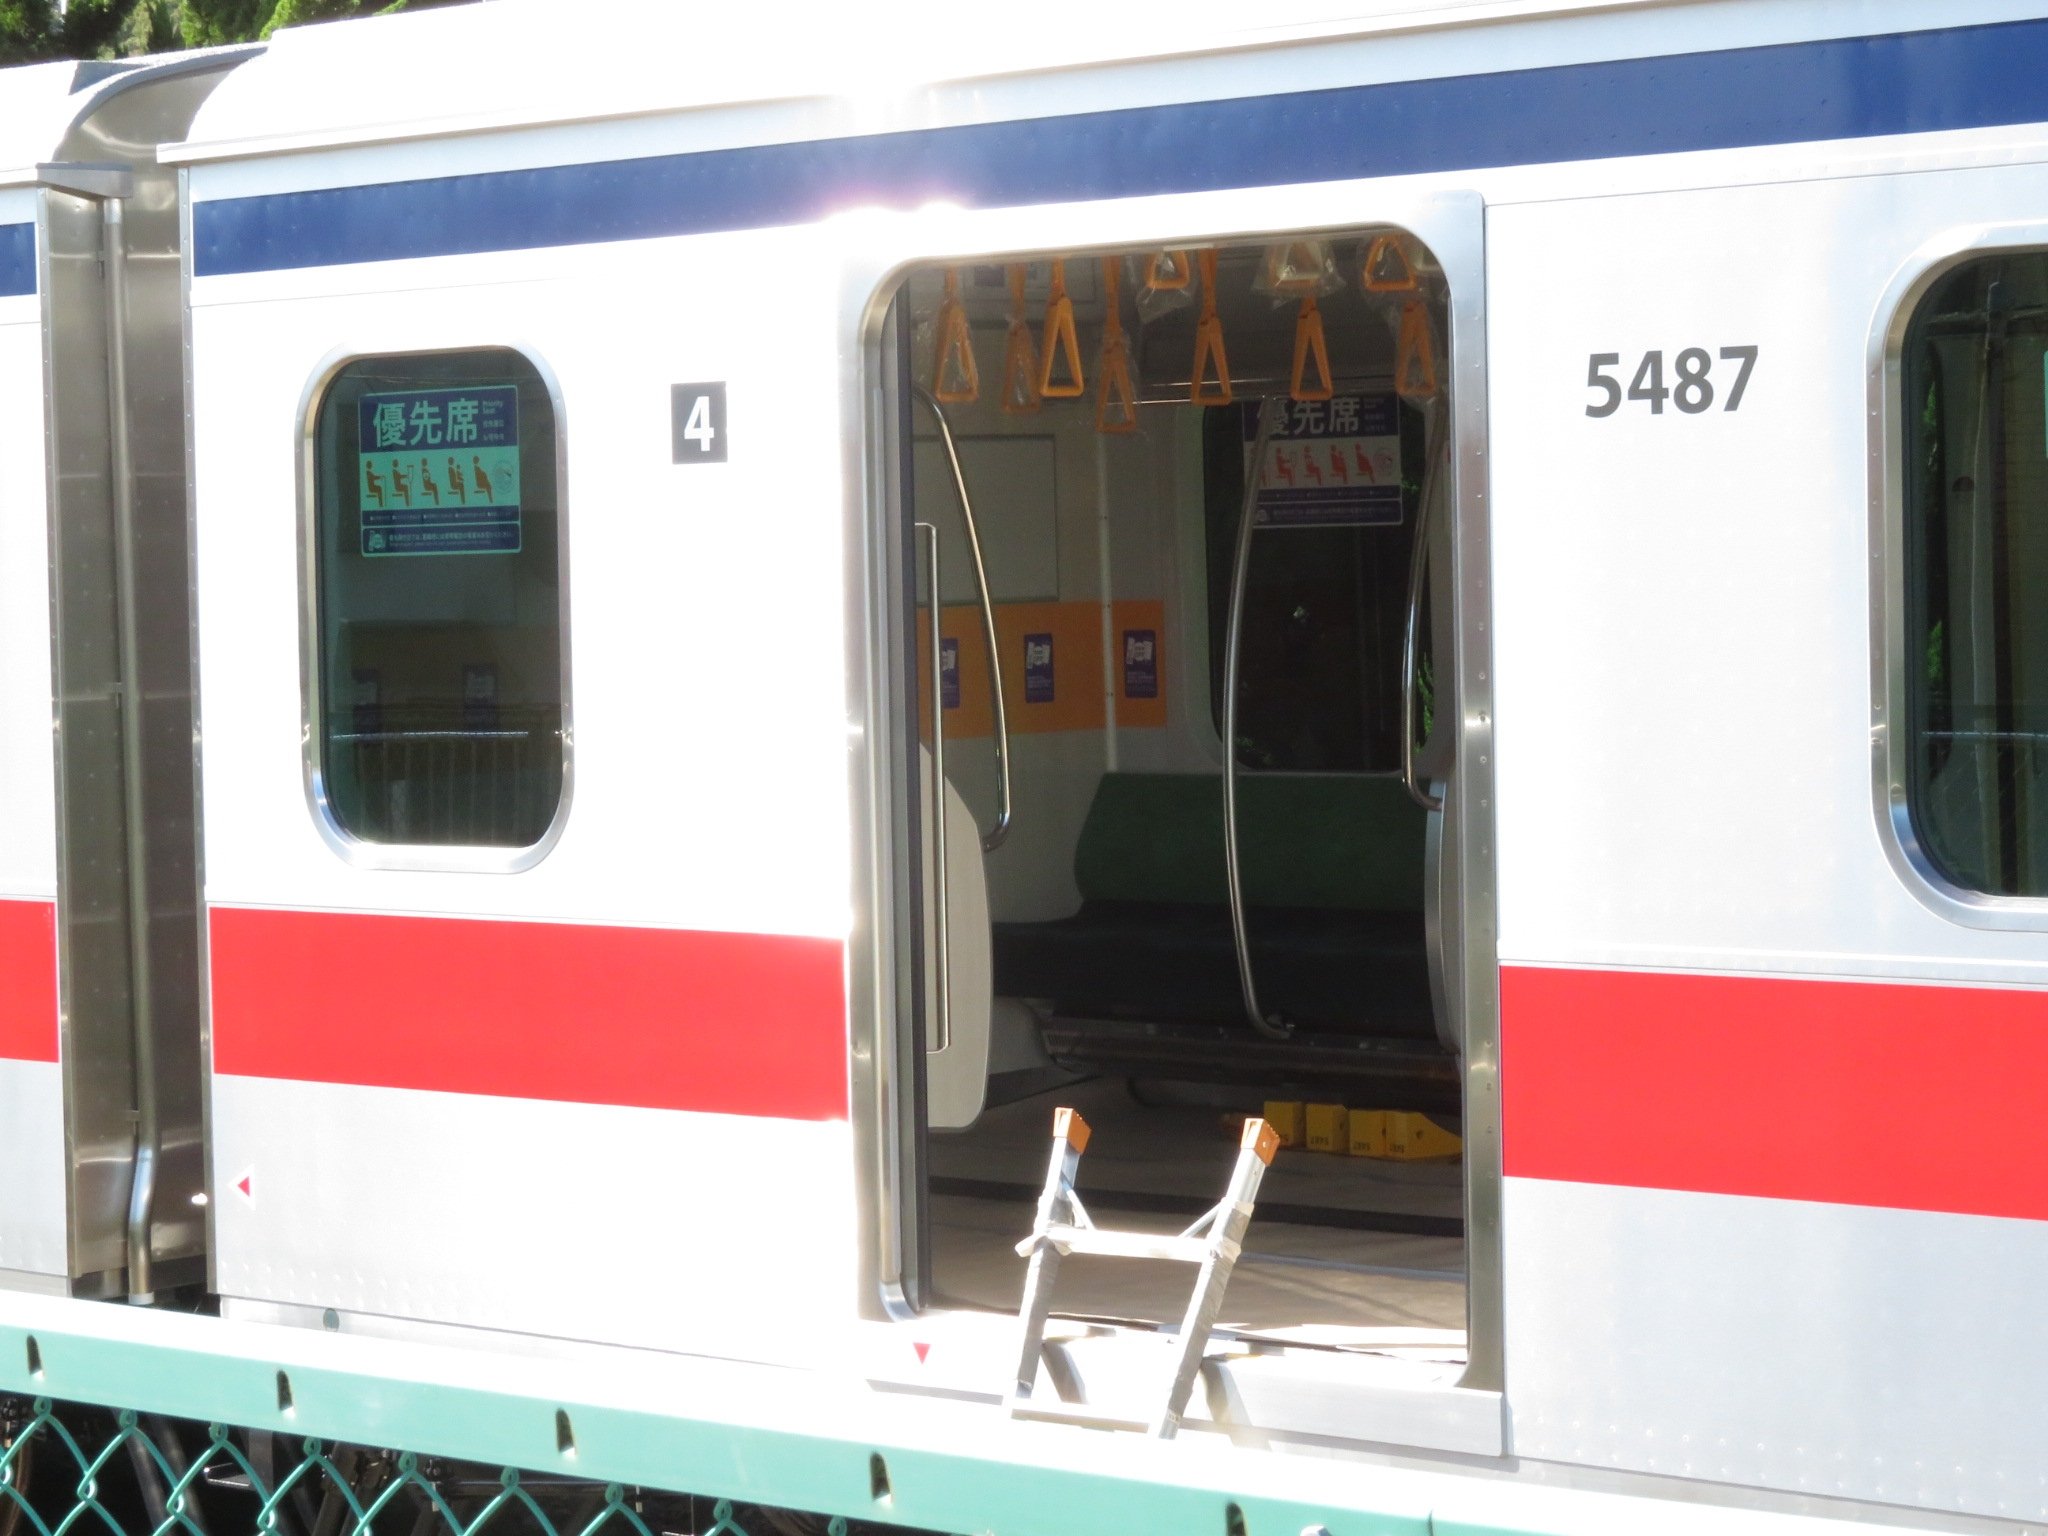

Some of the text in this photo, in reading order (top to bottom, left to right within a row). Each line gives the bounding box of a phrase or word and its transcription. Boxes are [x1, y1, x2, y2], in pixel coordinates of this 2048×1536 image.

[1585, 345, 1759, 418] 5487
[373, 398, 479, 448] 優先席
[683, 395, 715, 452] 4
